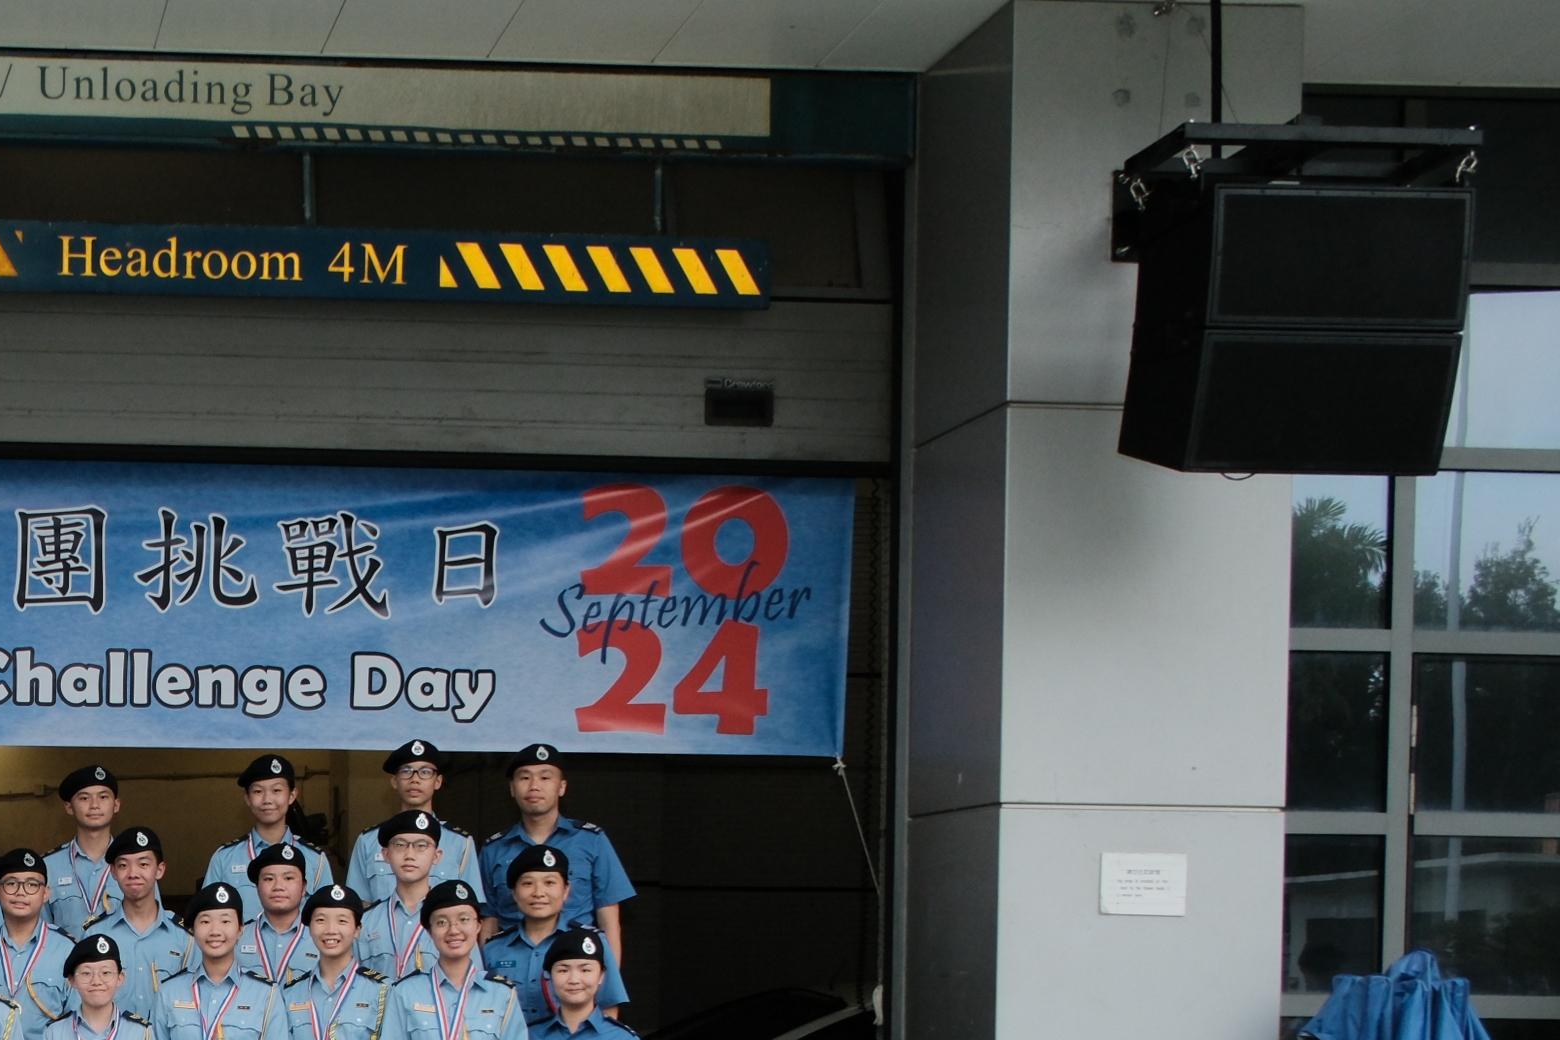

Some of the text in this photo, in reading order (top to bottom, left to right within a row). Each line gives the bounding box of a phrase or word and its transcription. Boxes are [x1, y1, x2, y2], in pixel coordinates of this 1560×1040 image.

[37, 66, 253, 115] Unloading
[266, 72, 345, 116] Bay
[57, 235, 408, 285] Headroom 4M
[580, 483, 788, 598] 20
[539, 561, 811, 665] September
[350, 650, 496, 723] Day
[575, 618, 768, 736] 24
